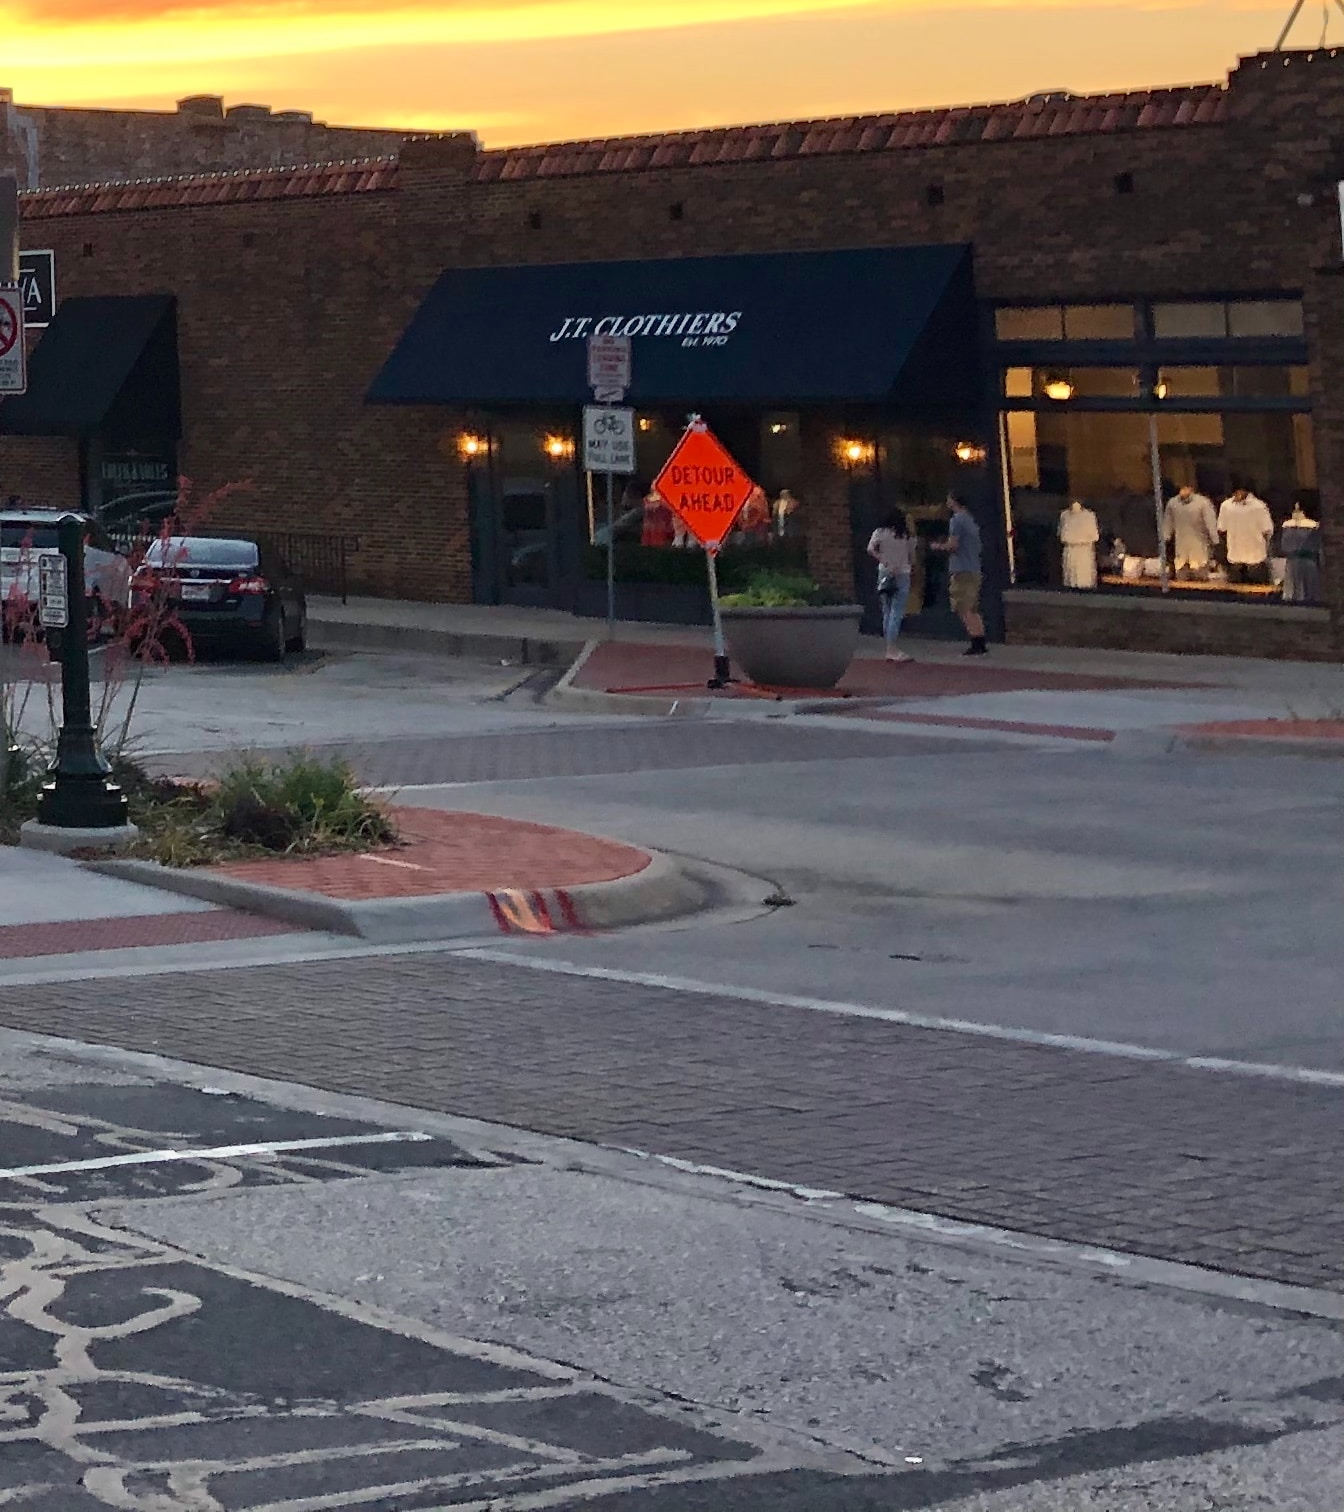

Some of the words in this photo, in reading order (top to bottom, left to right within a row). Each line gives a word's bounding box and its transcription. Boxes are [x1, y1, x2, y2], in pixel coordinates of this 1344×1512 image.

[594, 311, 743, 338] CLOTHIERS
[671, 465, 735, 485] DETOUR
[679, 492, 735, 513] AHEAD
